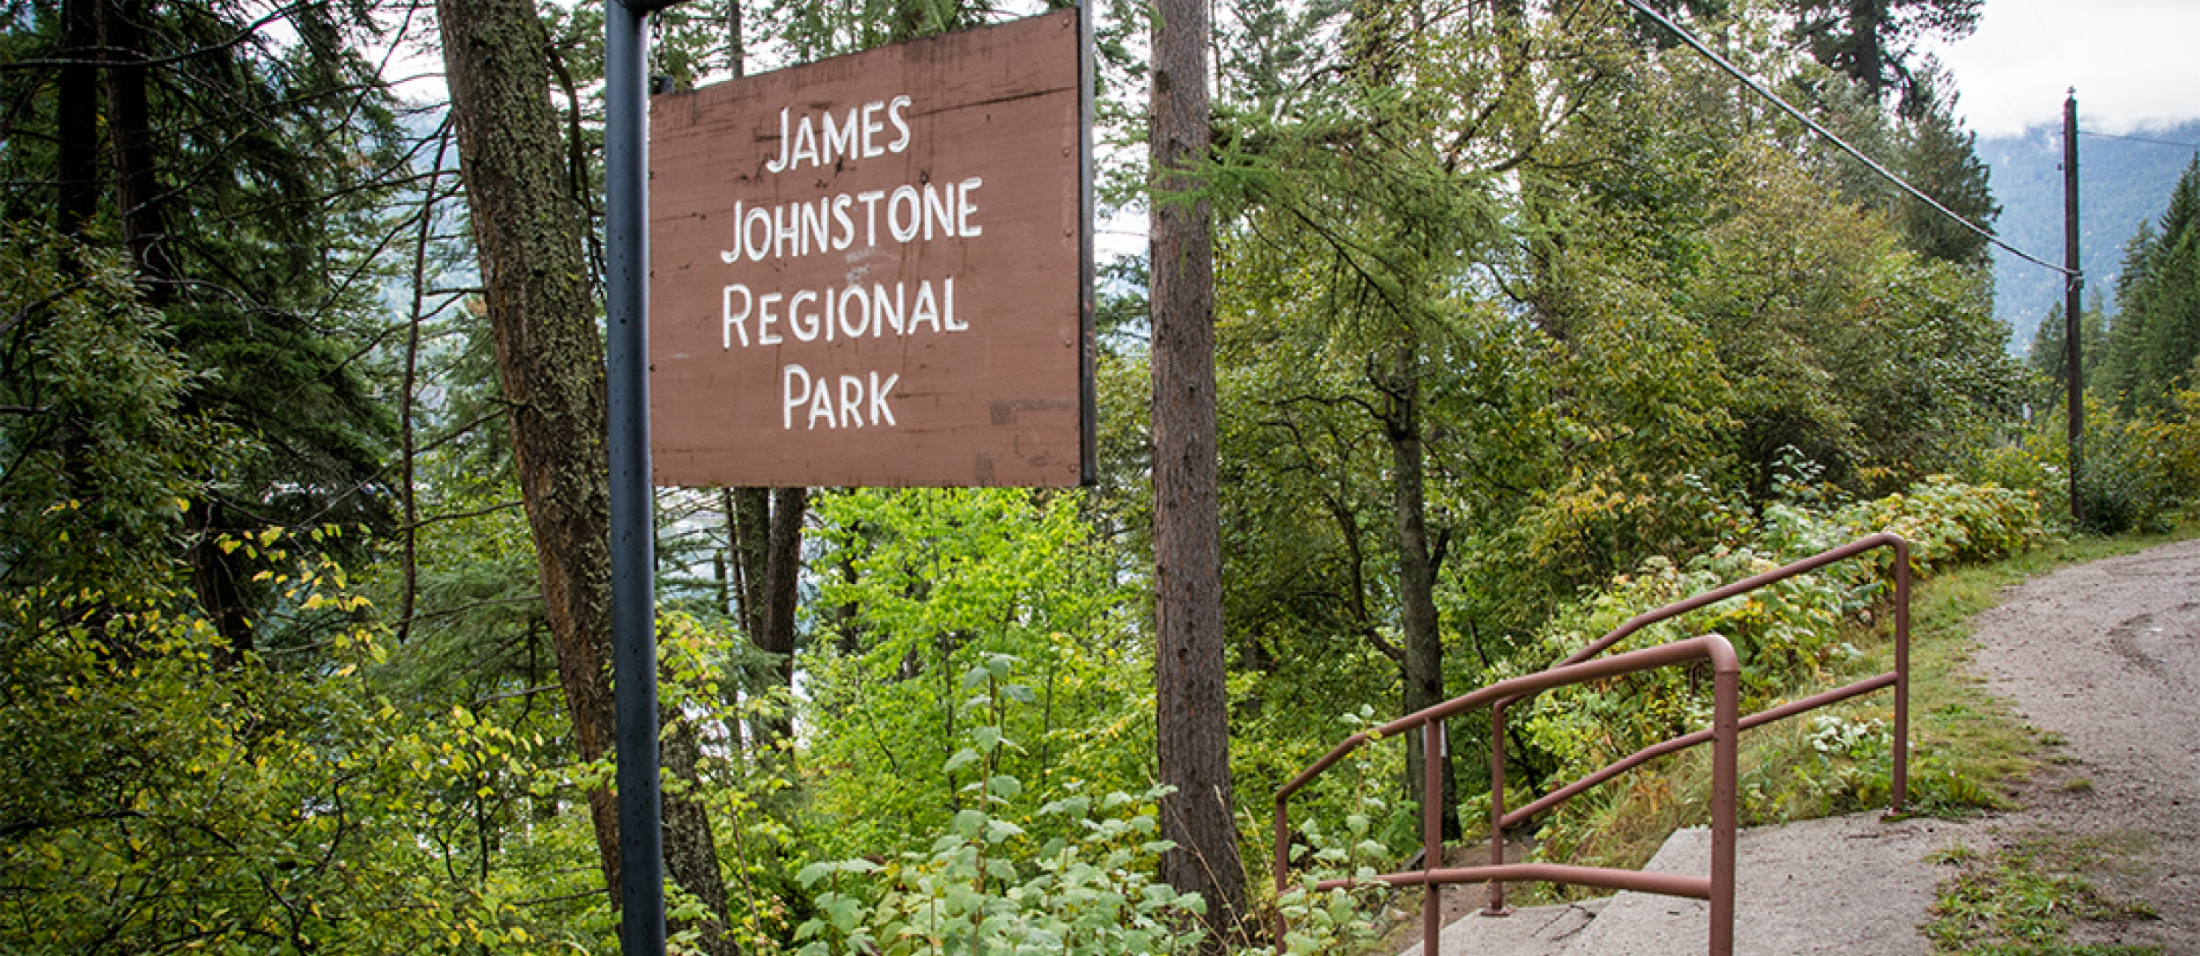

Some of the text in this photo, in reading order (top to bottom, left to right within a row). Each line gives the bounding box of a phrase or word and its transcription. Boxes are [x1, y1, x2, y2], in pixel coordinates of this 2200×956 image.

[766, 95, 912, 173] JAMES
[720, 177, 983, 264] JOHNSTONE
[723, 277, 969, 349] REGIONAL
[783, 364, 899, 430] PARK
